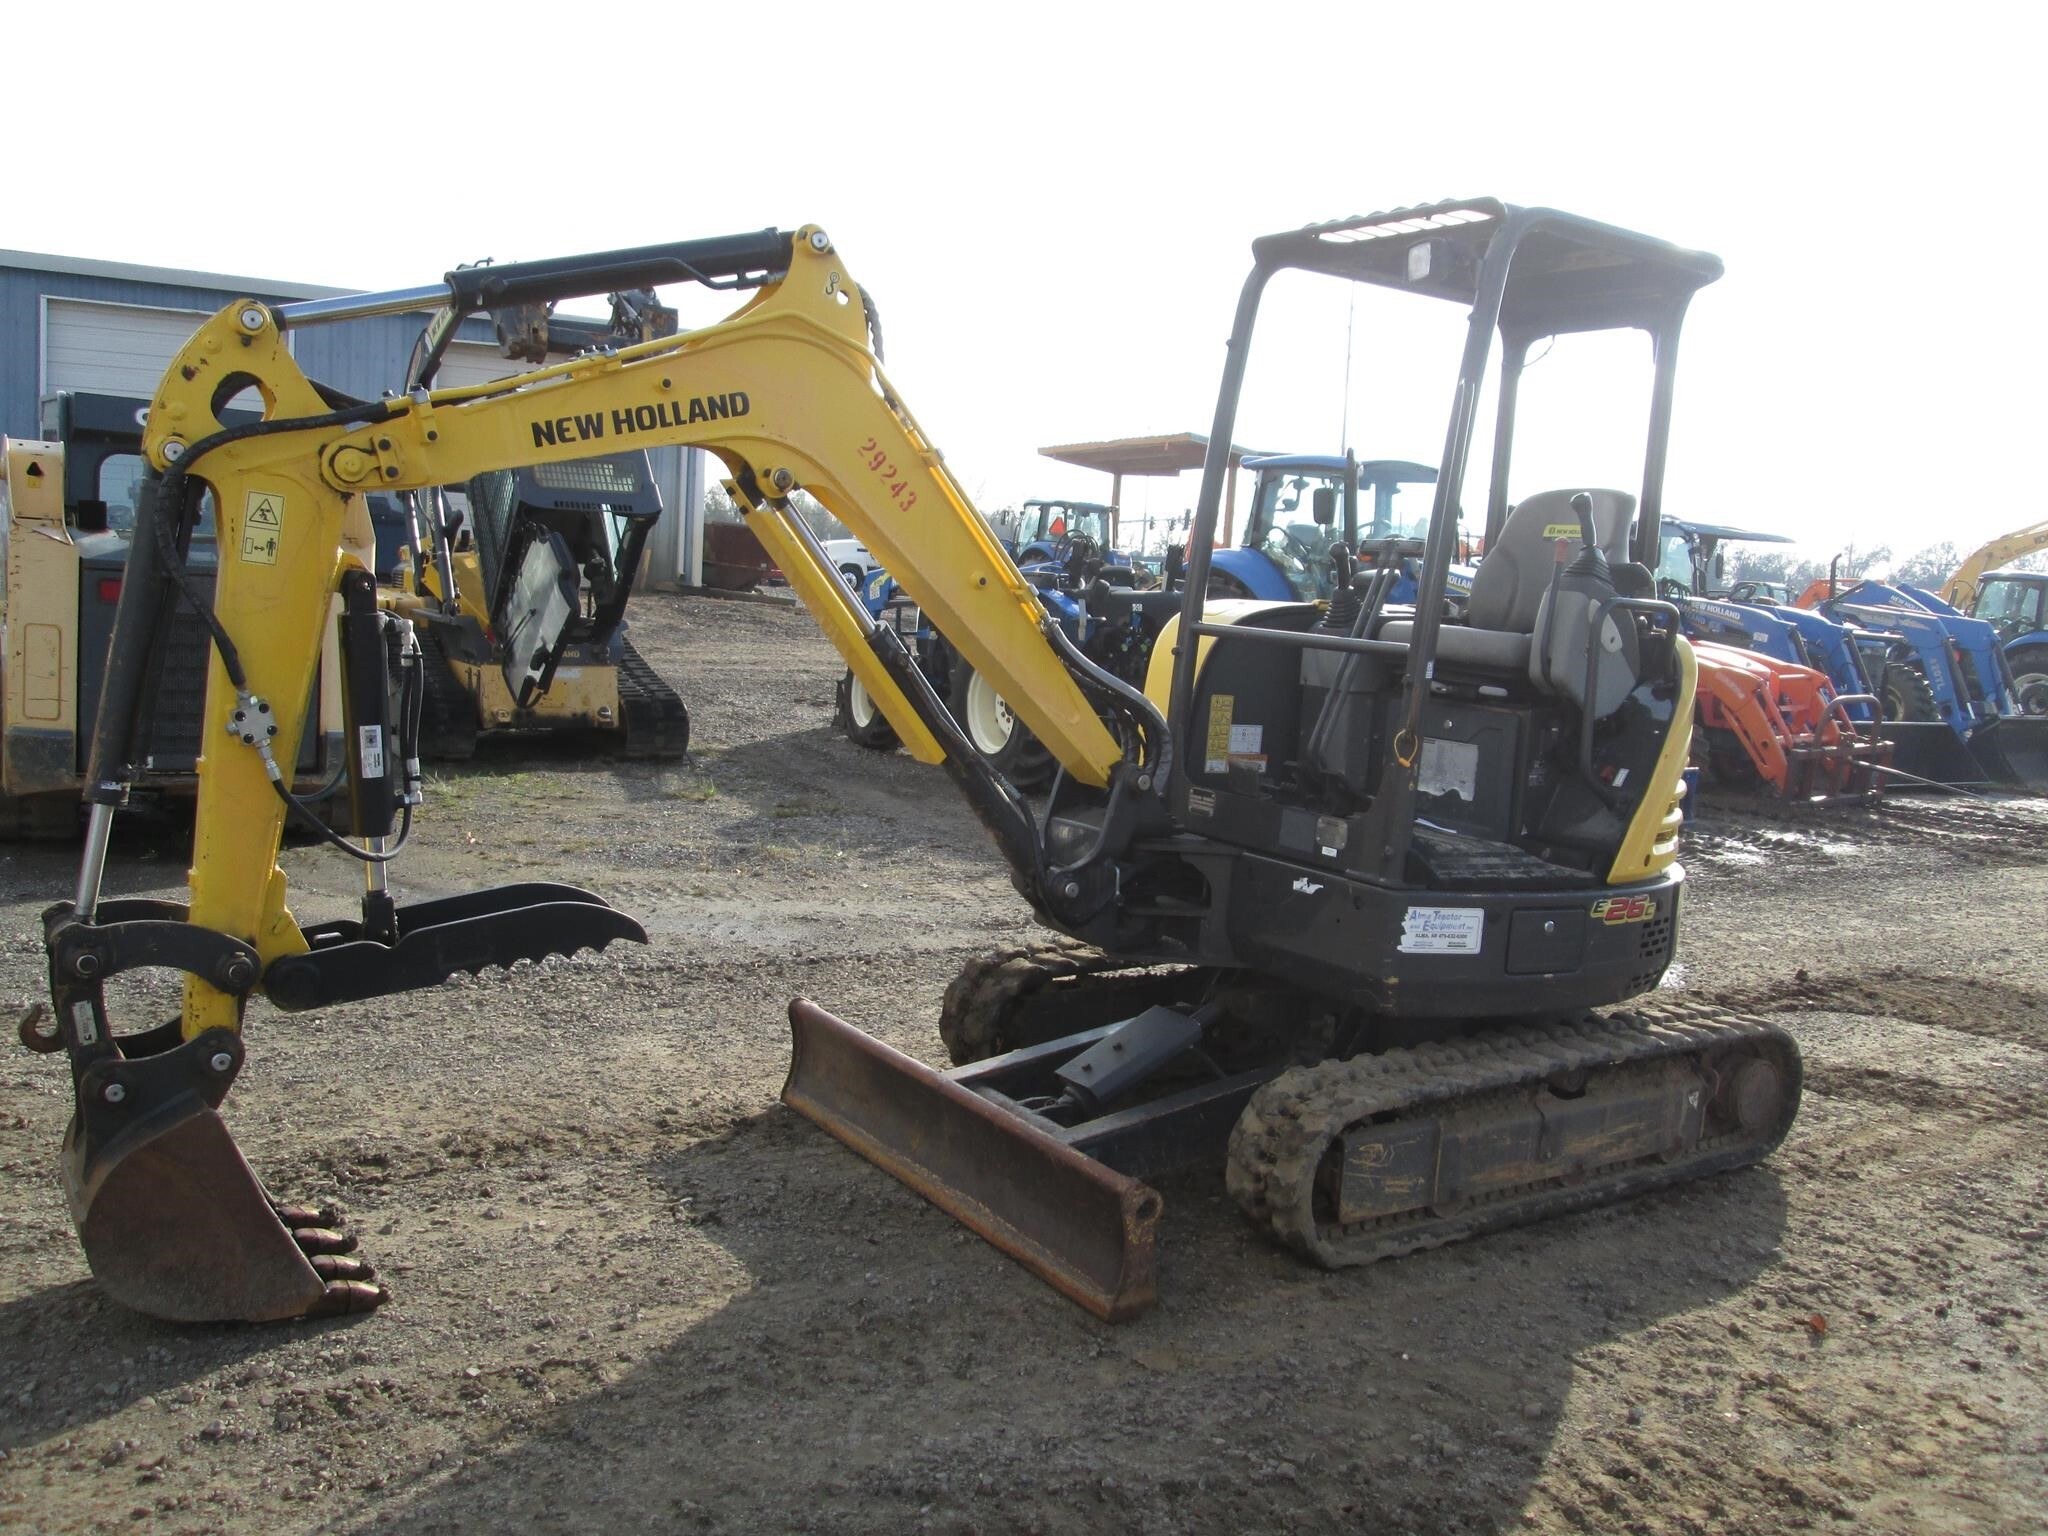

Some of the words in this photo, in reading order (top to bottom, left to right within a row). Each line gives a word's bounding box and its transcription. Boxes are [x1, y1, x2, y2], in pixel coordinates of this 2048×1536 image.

[531, 413, 603, 448] NEW
[611, 391, 750, 435] HOLLAND
[857, 436, 918, 513] 29243
[1446, 574, 1473, 590] OLLAN
[1707, 605, 1741, 620] HOLLAND
[1409, 910, 1431, 921] Alma
[1432, 911, 1463, 921] Tractor
[1422, 920, 1465, 931] Equipment
